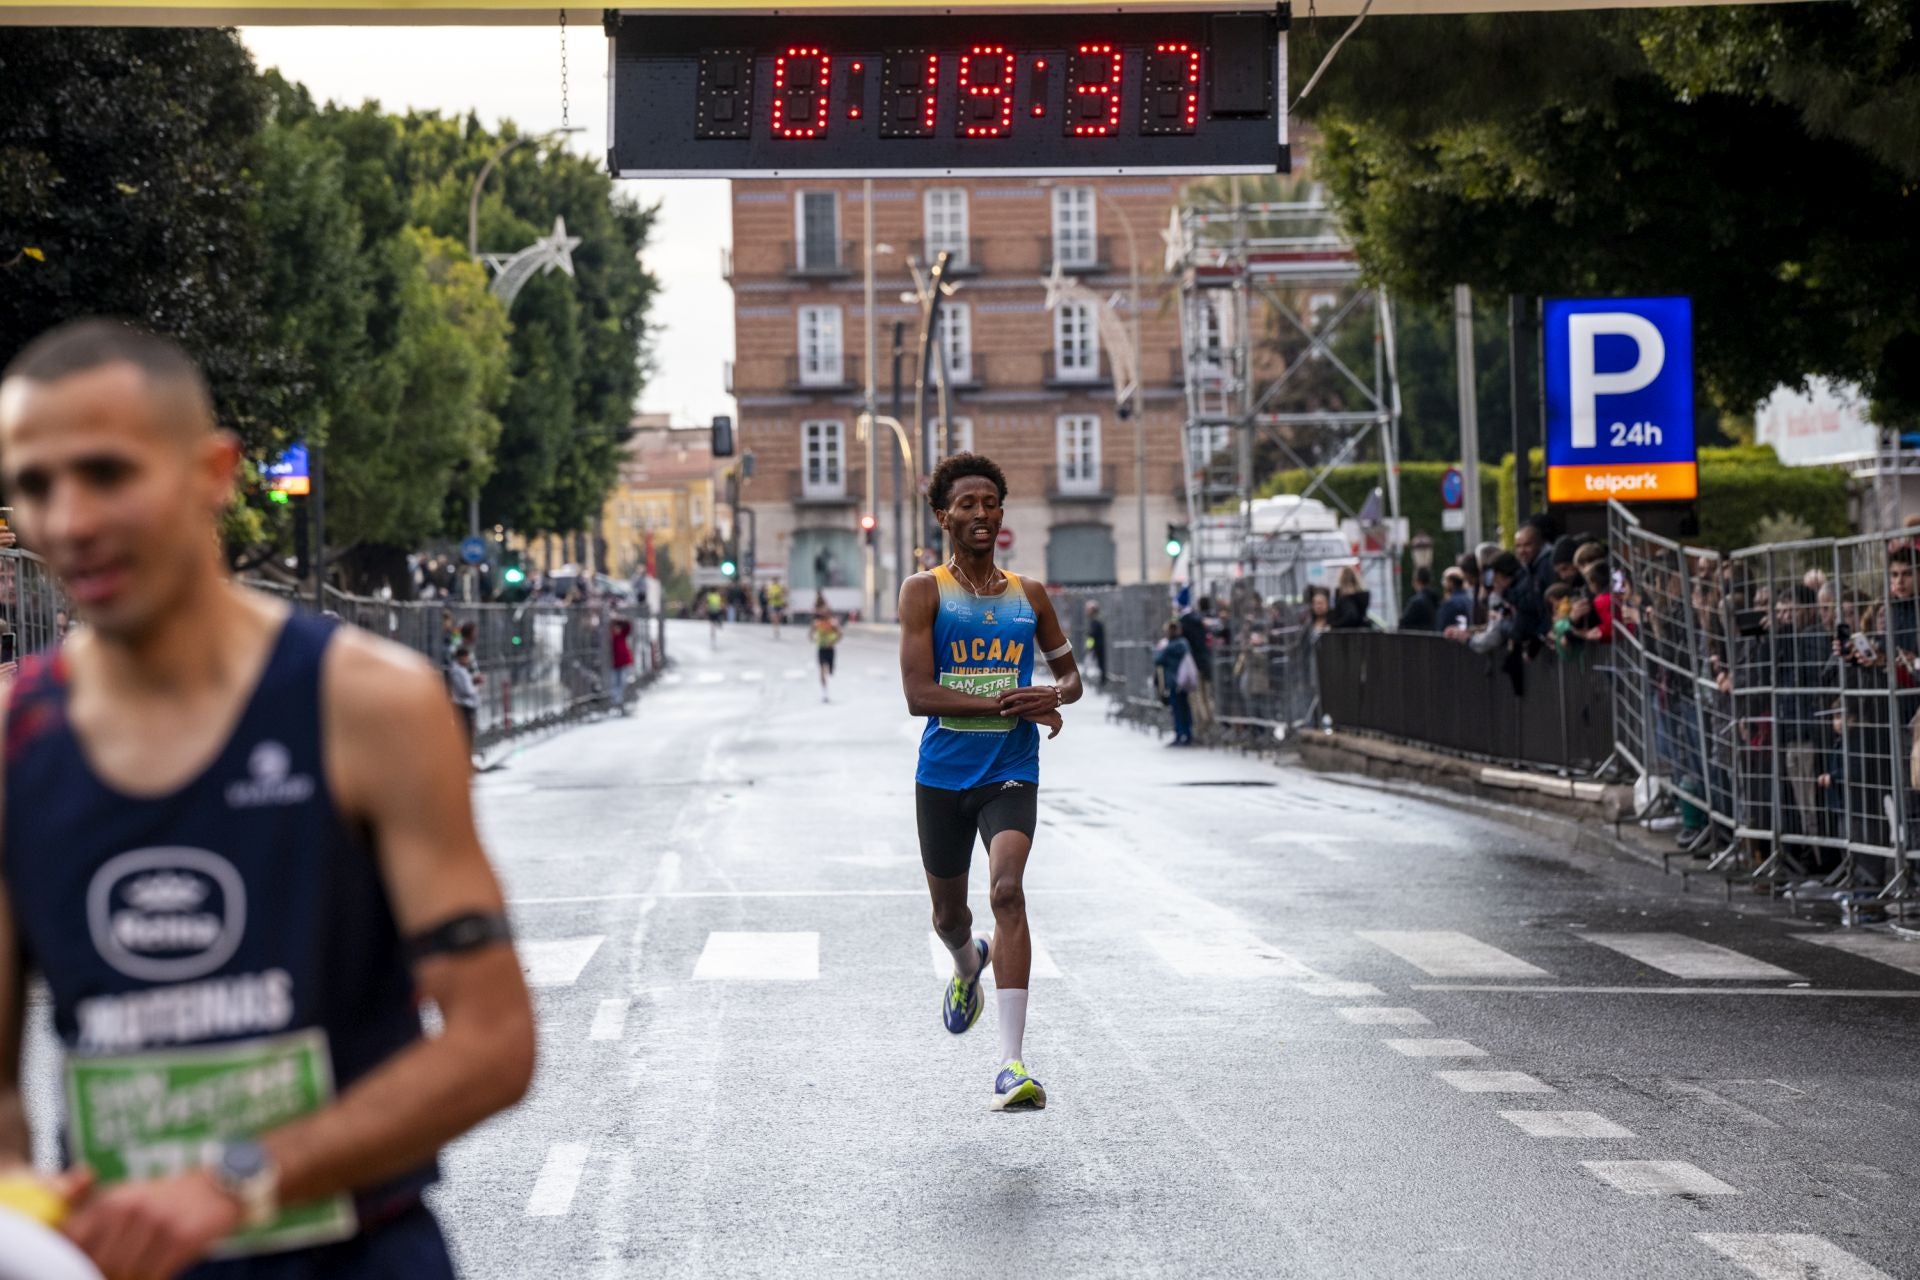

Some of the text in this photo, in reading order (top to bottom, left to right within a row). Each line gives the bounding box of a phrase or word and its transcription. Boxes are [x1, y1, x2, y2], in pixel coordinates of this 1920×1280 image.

[771, 44, 1199, 138] 0:19:37
[1568, 311, 1666, 448] P
[1610, 421, 1663, 447] 24h
[1584, 473, 1657, 493] telpark
[951, 638, 1024, 665] UCAM
[949, 678, 975, 690] SAN
